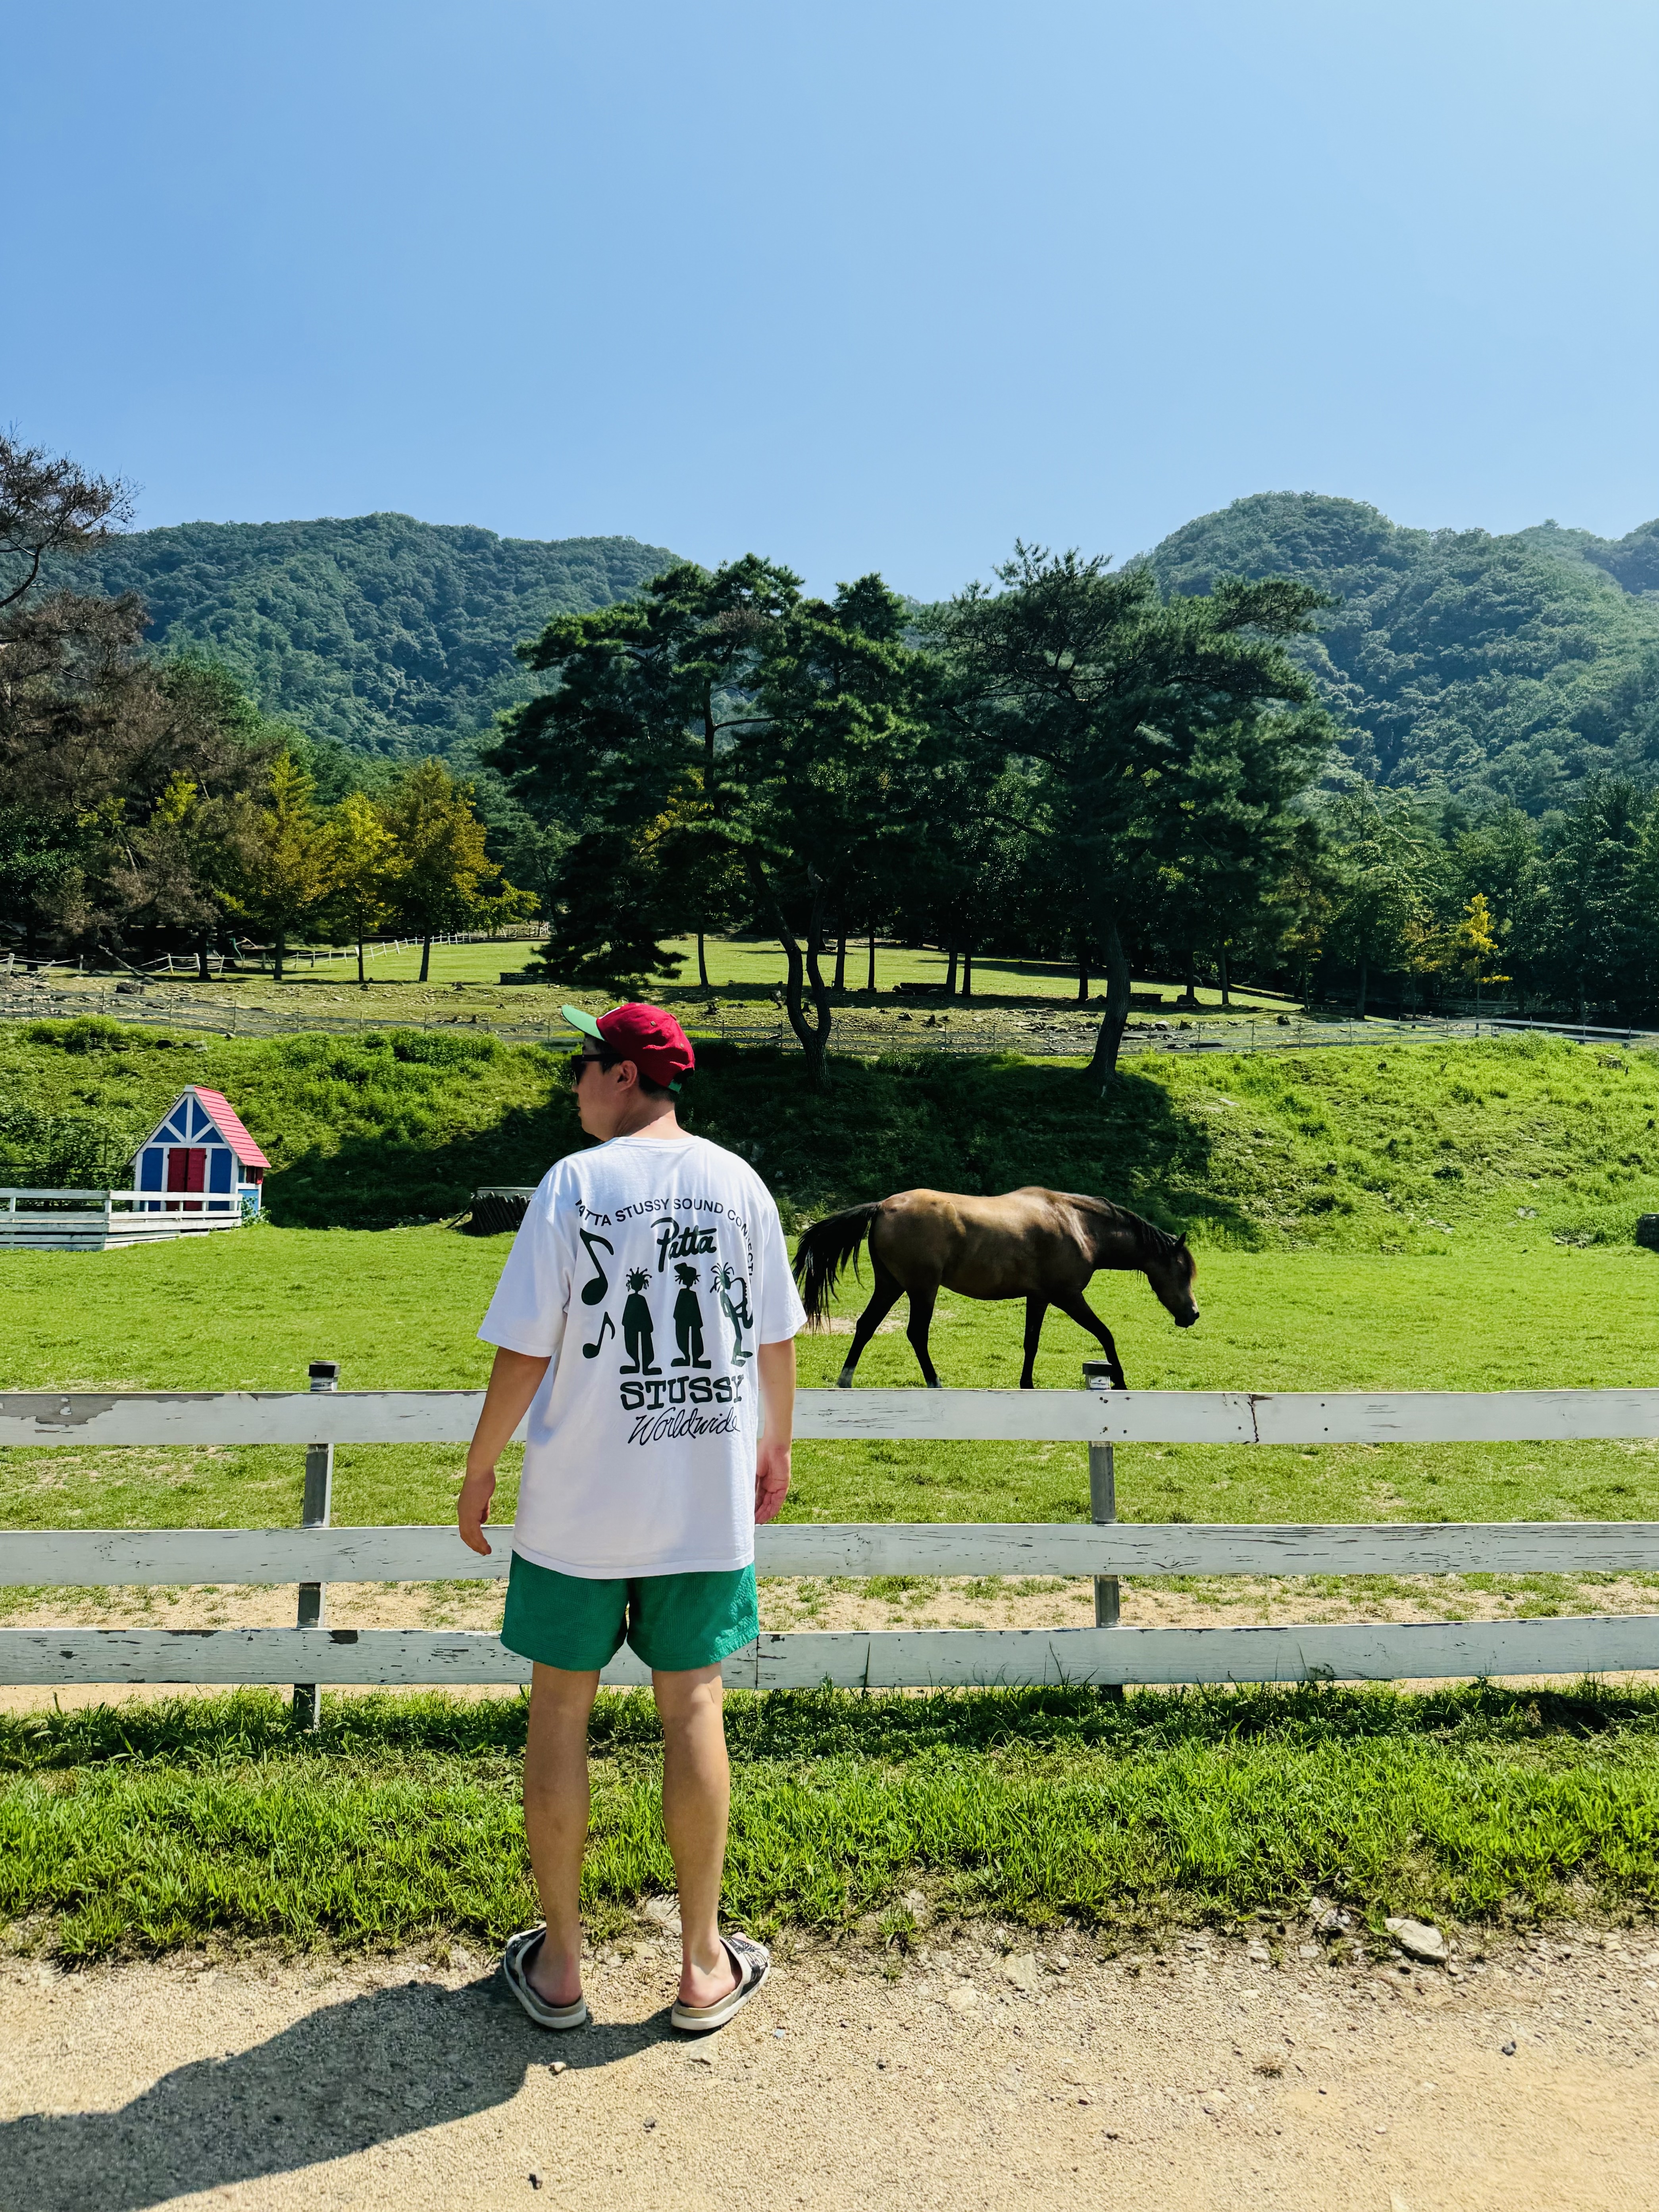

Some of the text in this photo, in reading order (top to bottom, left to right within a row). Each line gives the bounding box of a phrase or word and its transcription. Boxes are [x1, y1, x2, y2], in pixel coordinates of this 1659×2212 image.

[575, 1199, 612, 1226] PATTA
[615, 1198, 669, 1222] STUSSY
[674, 1198, 724, 1214] SOUND
[651, 1217, 717, 1272] Patta
[620, 1374, 744, 1410] STUSSY
[627, 1407, 741, 1446] Worldwide
